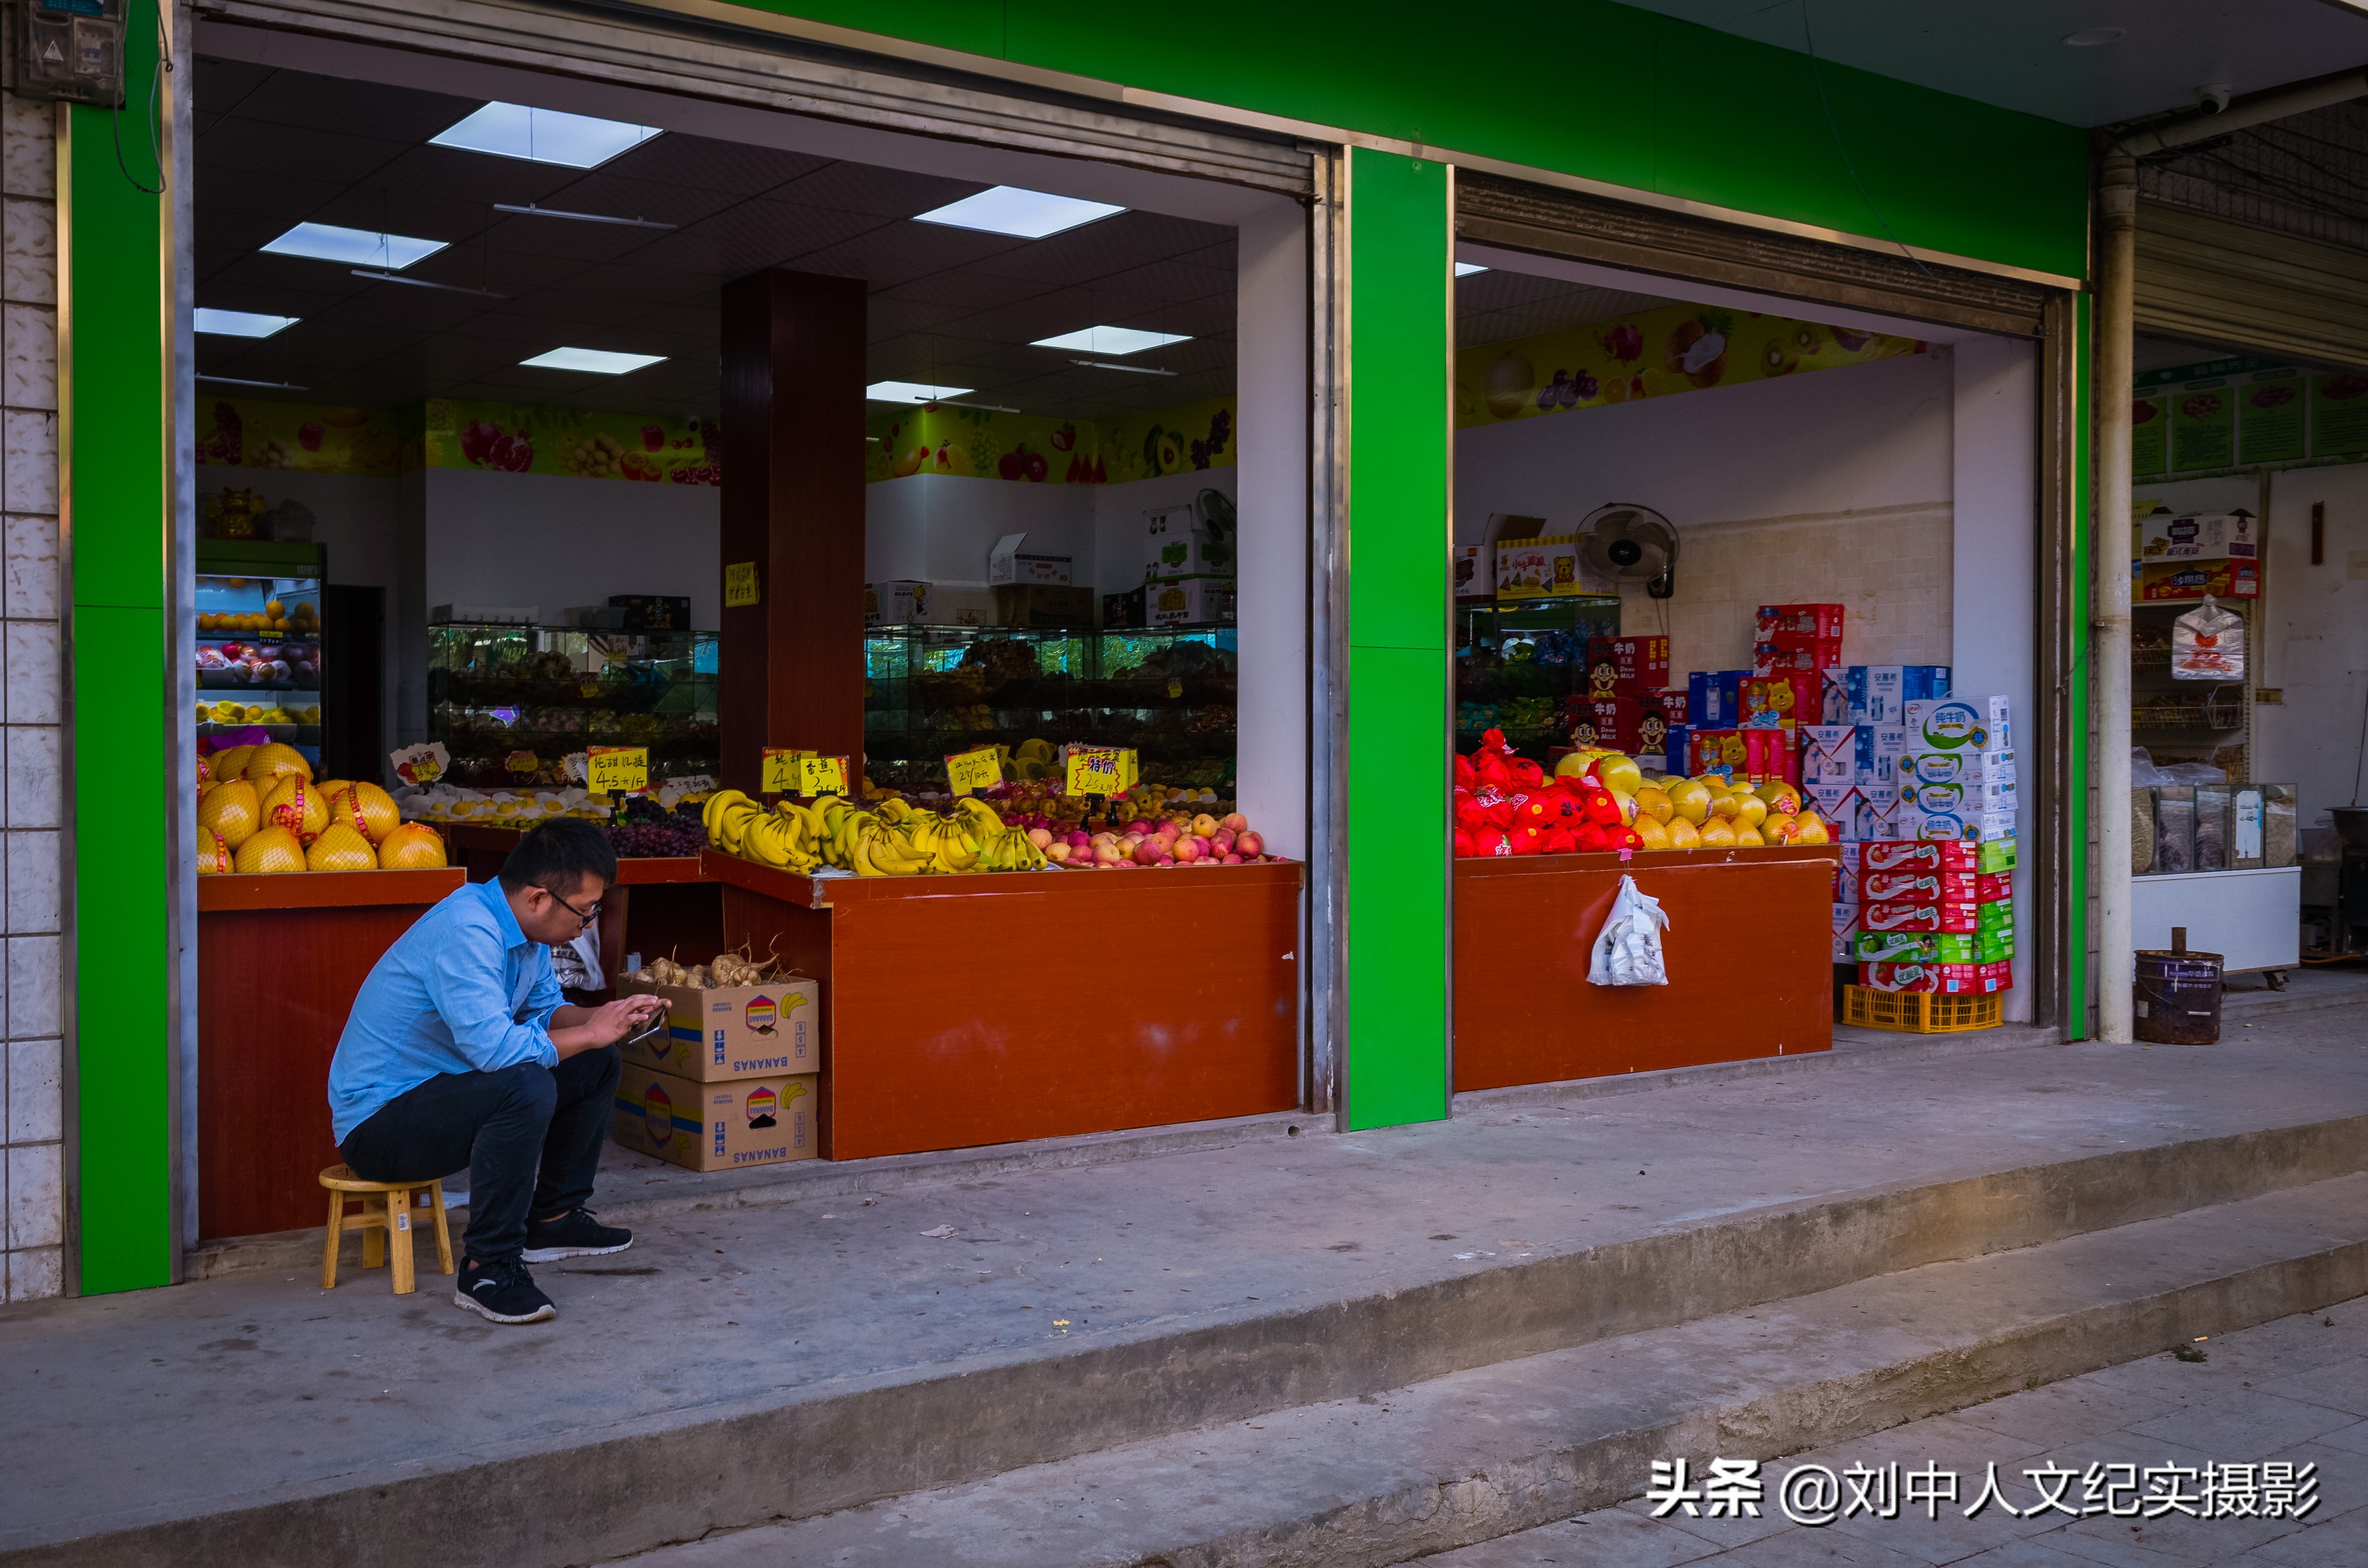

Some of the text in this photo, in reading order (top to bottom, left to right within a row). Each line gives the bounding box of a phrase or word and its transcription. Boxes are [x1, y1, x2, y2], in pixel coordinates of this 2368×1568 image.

[1590, 642, 1635, 655] 旺仔牛奶
[1874, 673, 1897, 682] 安慕希
[1639, 696, 1686, 709] 旺仔牛奶
[1571, 703, 1617, 716] 旺仔牛奶
[1935, 711, 1966, 724] 纯牛奶
[1817, 730, 1840, 739] 安慕希
[1881, 733, 1904, 742] 安慕希
[806, 758, 833, 775] 香蕉
[1089, 757, 1115, 775] 特价
[1817, 789, 1840, 798] 安慕希
[1870, 791, 1893, 799] 安慕希
[1899, 967, 1921, 982] 优酸乳
[734, 1056, 787, 1071] BANANAS
[733, 1147, 787, 1163] BANANAS
